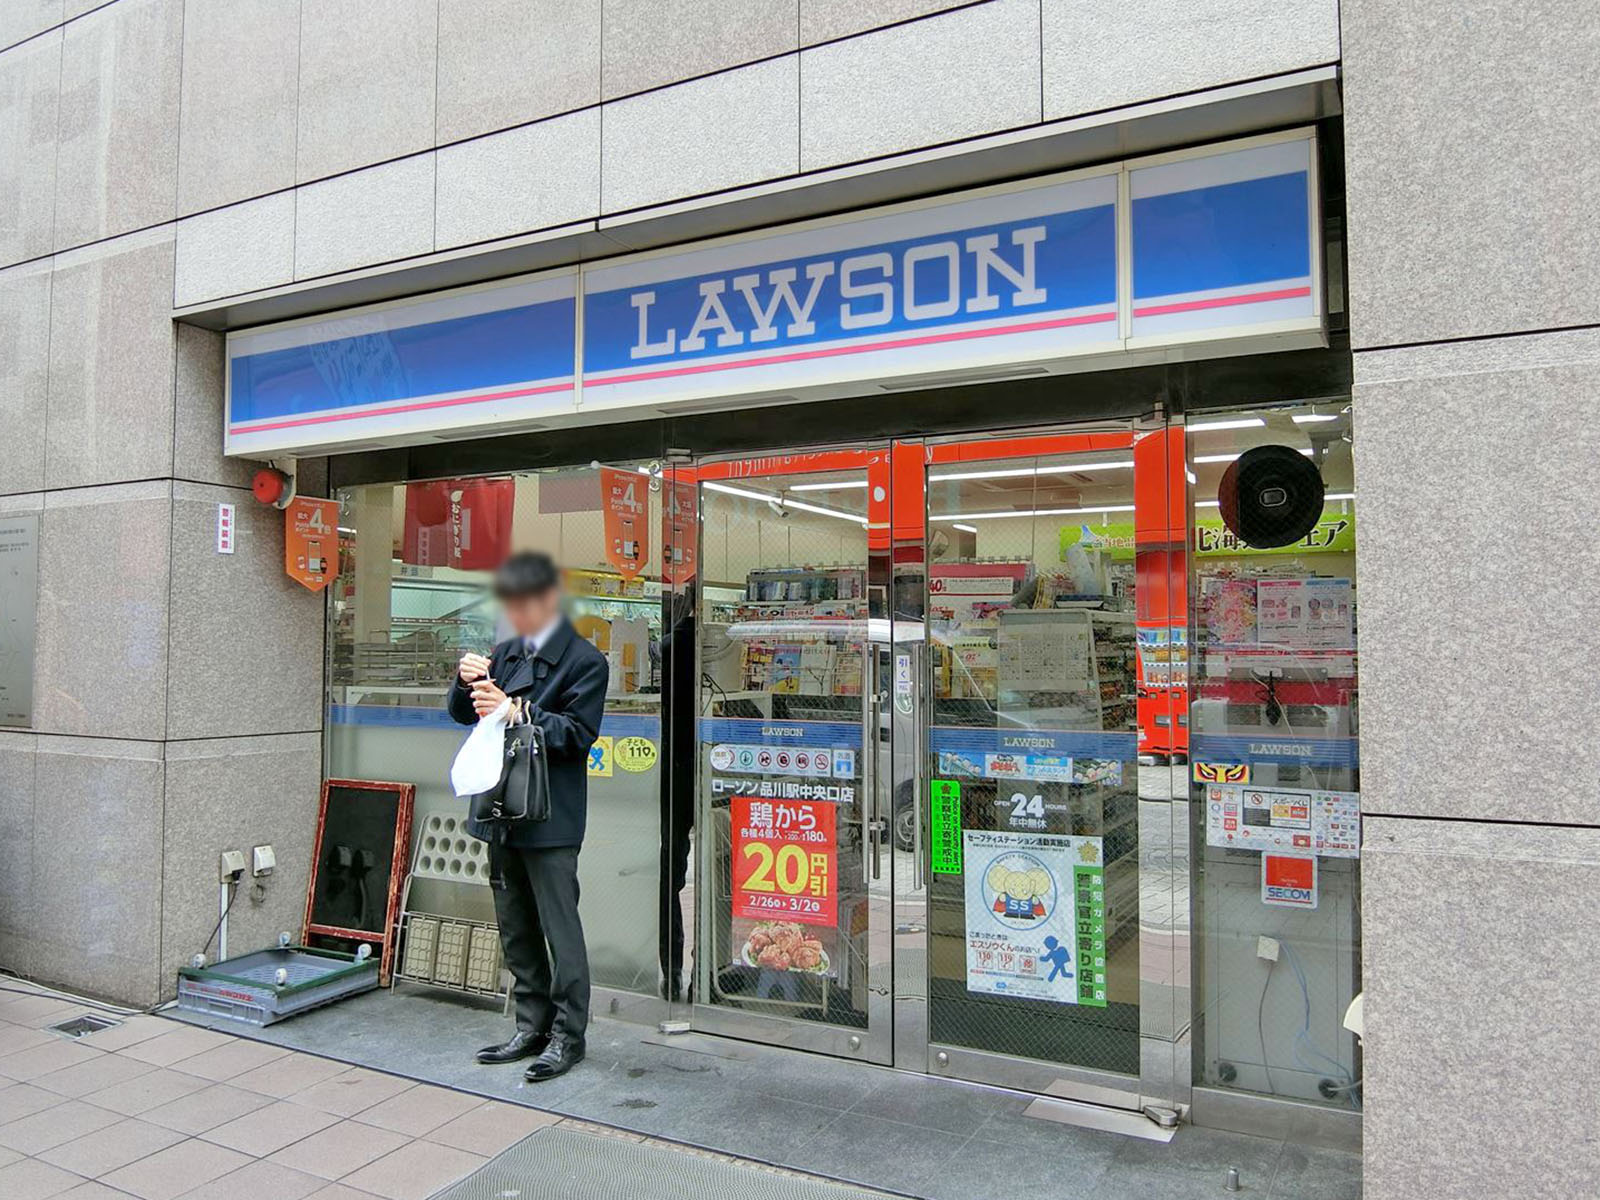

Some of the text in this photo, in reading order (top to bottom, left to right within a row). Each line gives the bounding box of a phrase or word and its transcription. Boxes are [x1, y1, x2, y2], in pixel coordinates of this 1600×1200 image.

[630, 226, 1046, 359] LAWSON
[761, 727, 804, 737] LAWSON
[1003, 737, 1055, 749] LAWSON
[1249, 743, 1312, 756] LAWSON
[1010, 793, 1045, 819] 24
[1045, 803, 1067, 811] HOURS
[750, 802, 817, 830] 鶏から
[1009, 817, 1048, 828] 年中無休
[741, 842, 809, 895] 20
[1268, 887, 1311, 900] SECOM
[1009, 901, 1029, 911] SS
